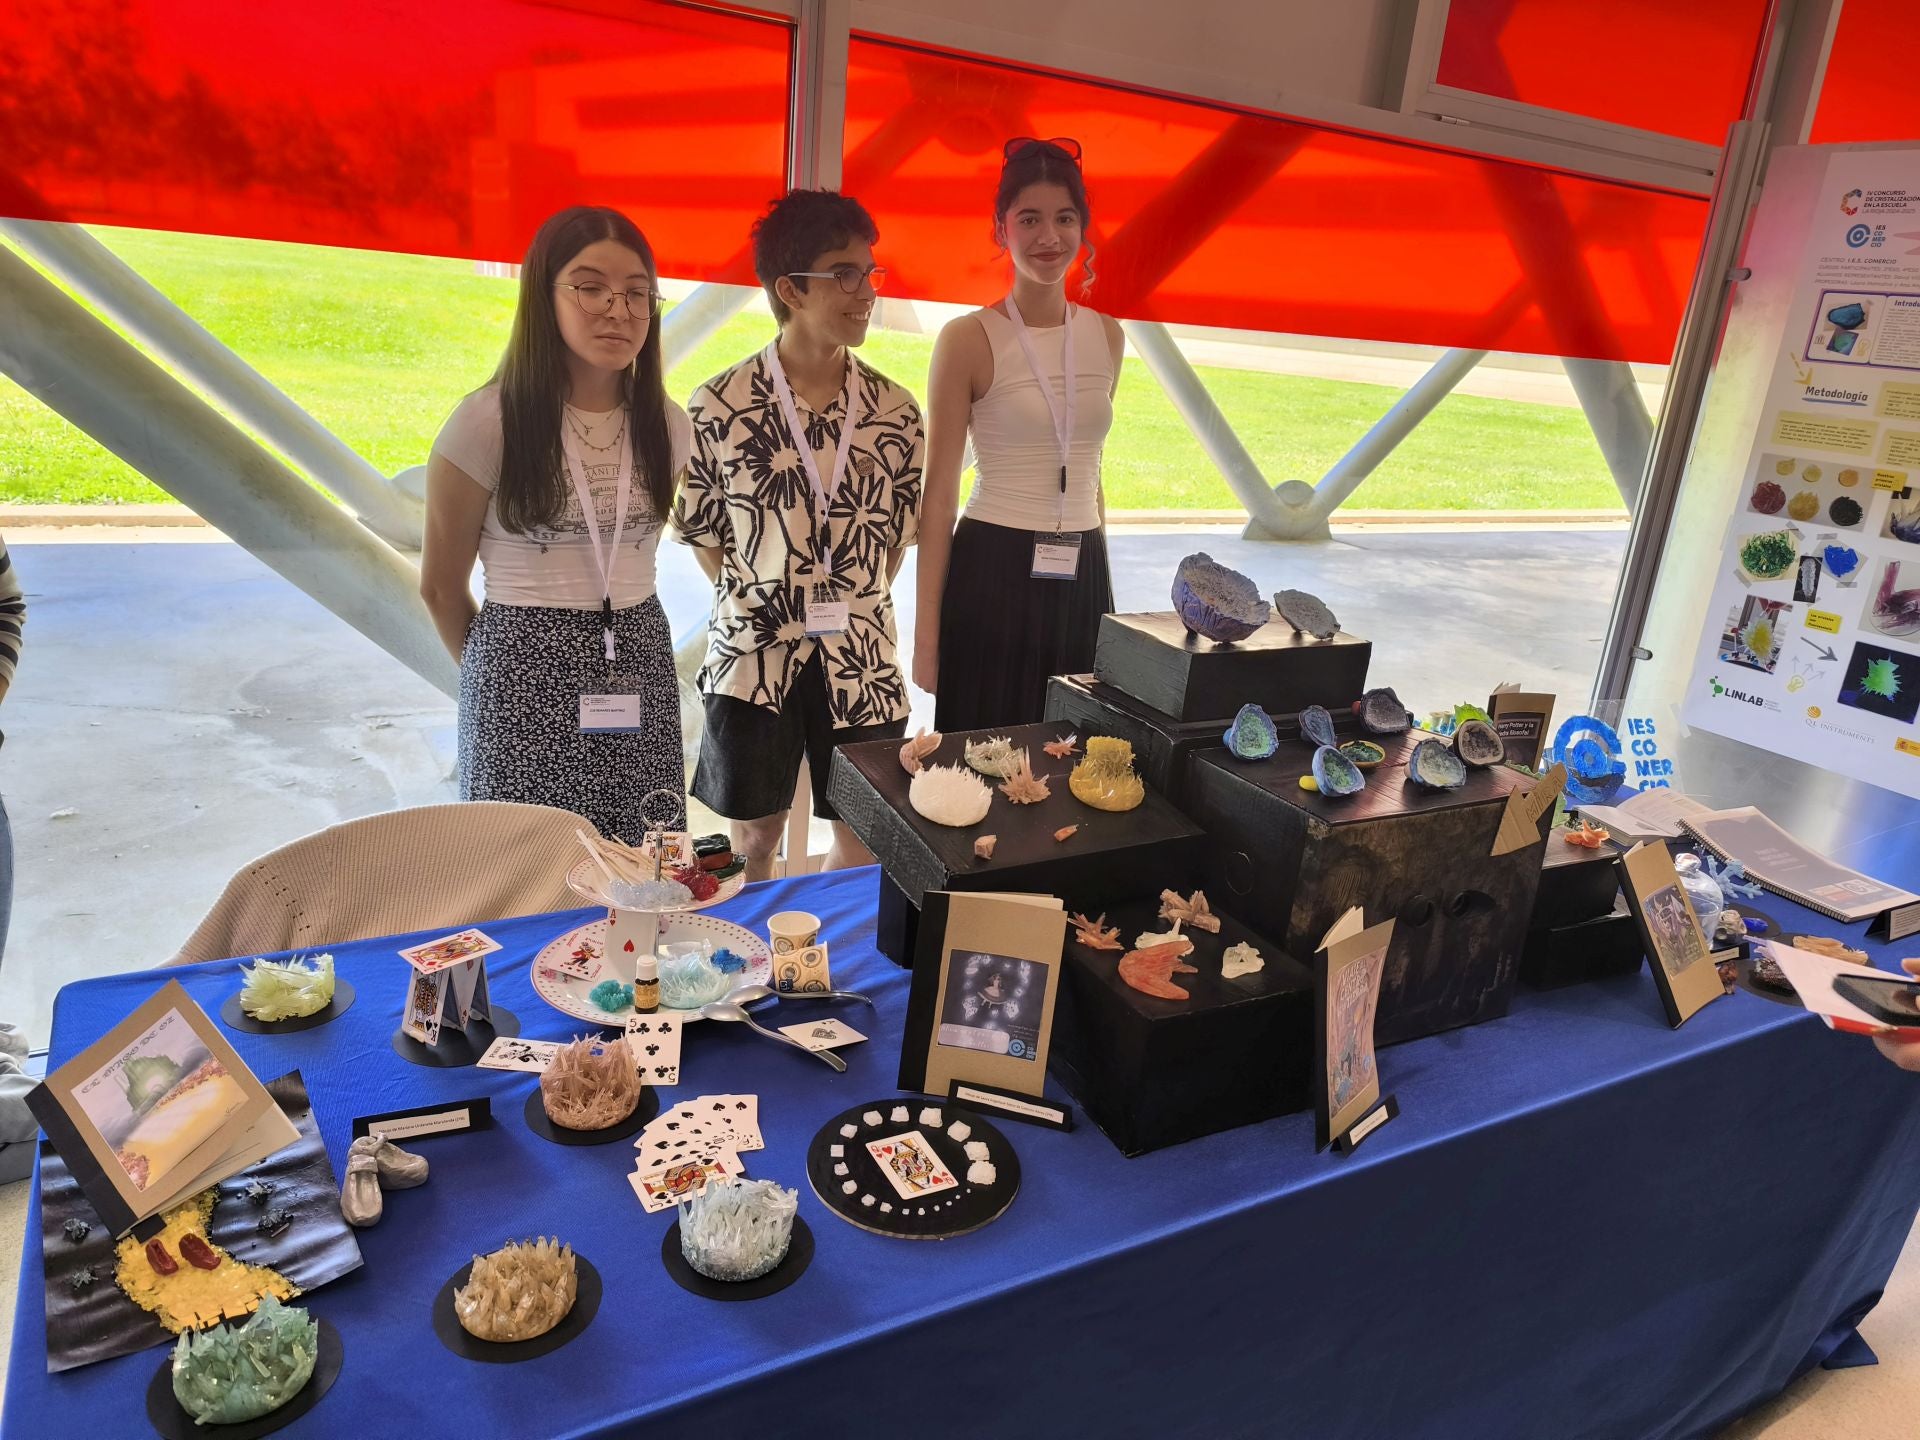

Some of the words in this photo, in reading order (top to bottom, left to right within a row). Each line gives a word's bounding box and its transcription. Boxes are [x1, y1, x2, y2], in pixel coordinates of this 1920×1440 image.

[1805, 386, 1868, 402] Metodología
[1724, 687, 1764, 707] LINLAB
[1627, 718, 1656, 735] IES
[1631, 738, 1657, 757] CO
[1635, 758, 1674, 777] MER
[629, 1018, 637, 1028] 5
[668, 1073, 676, 1083] 5
